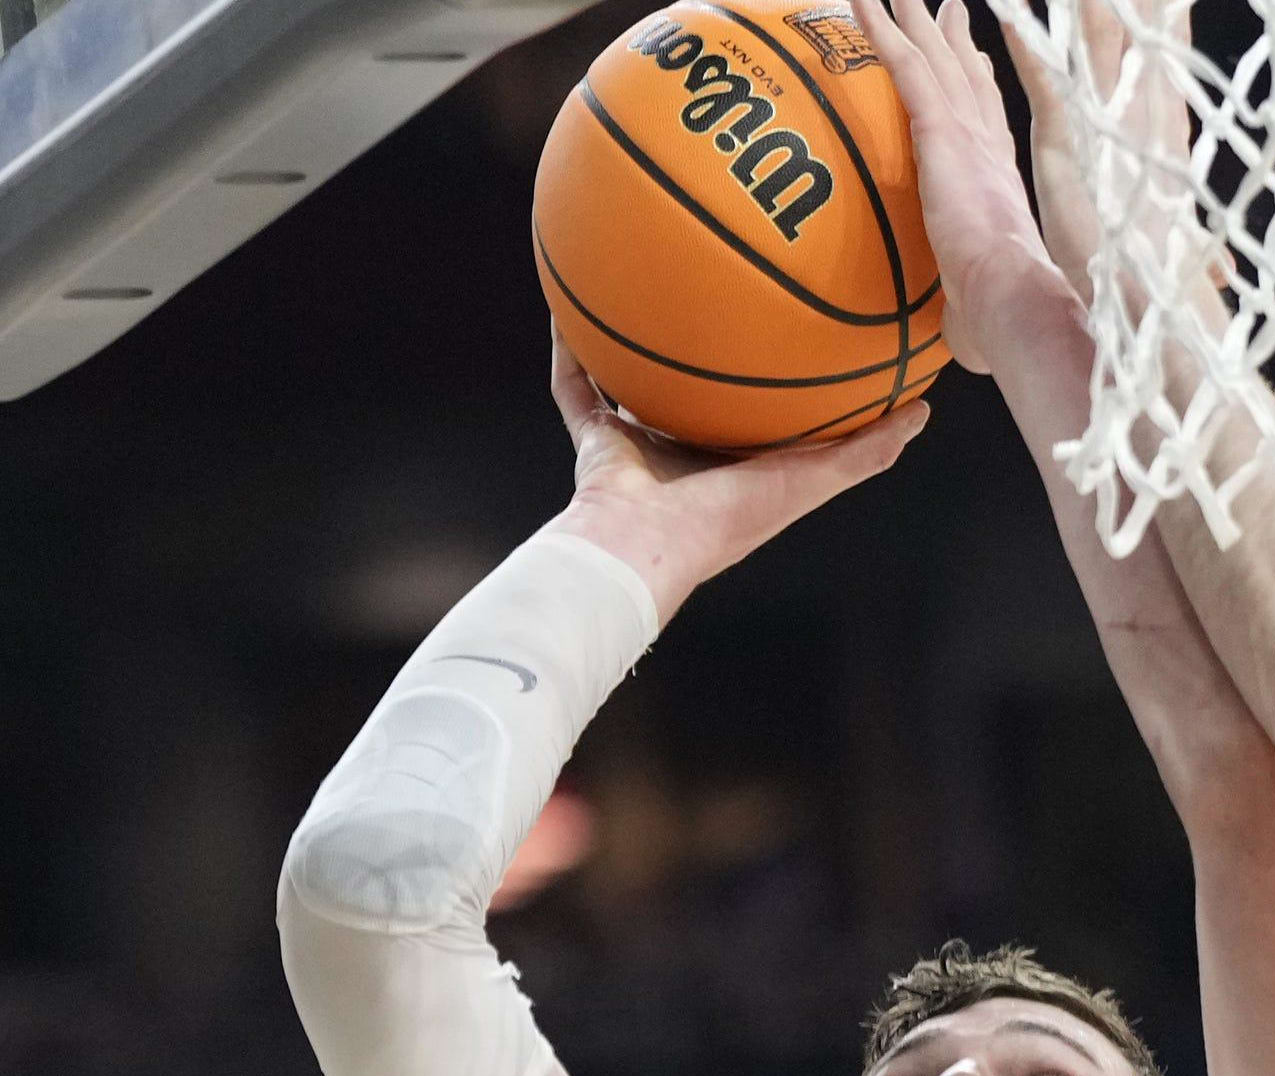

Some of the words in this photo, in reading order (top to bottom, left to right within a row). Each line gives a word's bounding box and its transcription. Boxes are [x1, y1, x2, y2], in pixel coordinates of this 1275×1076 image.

[719, 39, 751, 64] NXT
[751, 66, 784, 97] EVO
[628, 16, 833, 242] Wilson
